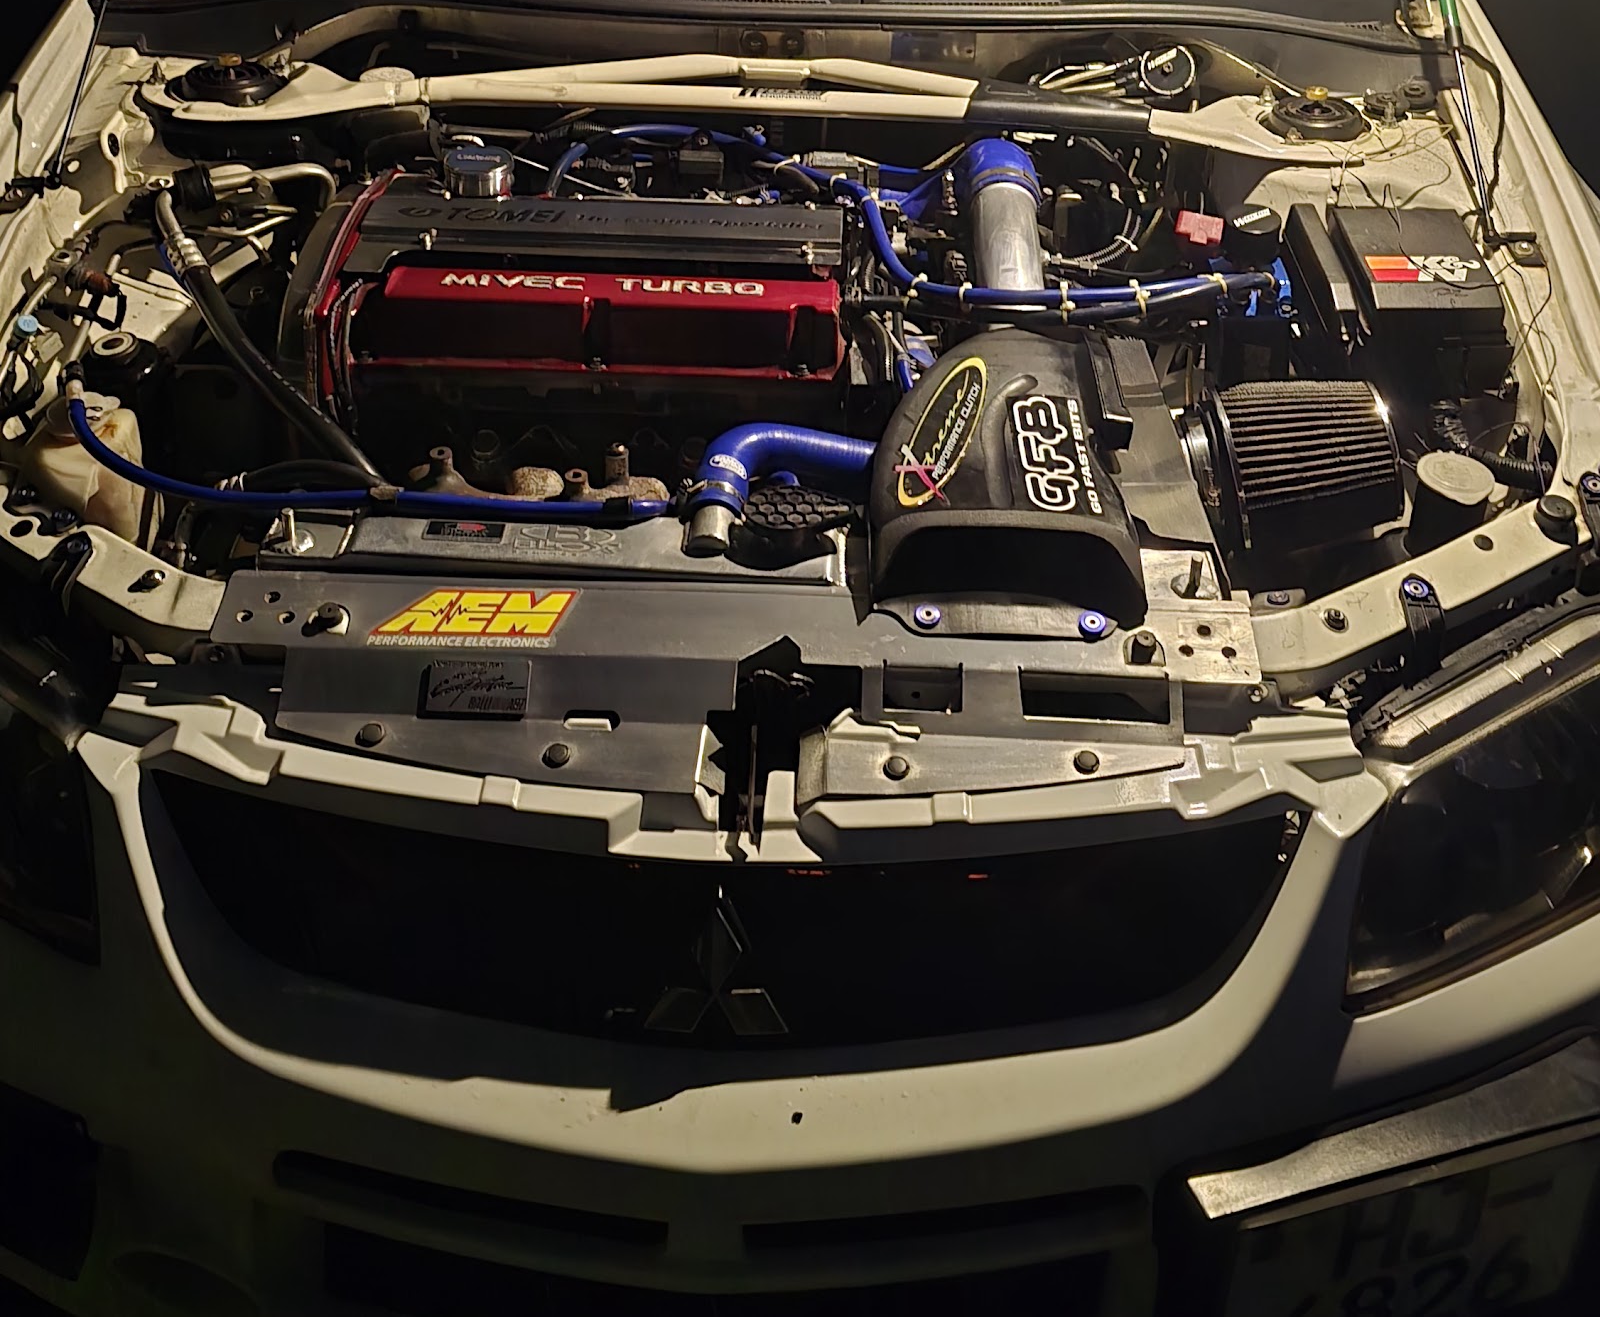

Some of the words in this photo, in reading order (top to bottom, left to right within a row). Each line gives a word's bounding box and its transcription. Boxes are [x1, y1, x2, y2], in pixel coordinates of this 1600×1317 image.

[447, 207, 565, 224] TOMEI
[440, 272, 586, 290] MIVEC
[615, 277, 764, 297] TURBO
[931, 417, 966, 481] PERFORMANCE
[960, 382, 981, 419] CLUTCH
[1066, 399, 1084, 441] BITS
[1012, 396, 1080, 512] GFB
[1074, 441, 1095, 488] FAST
[1086, 489, 1103, 514] GO
[372, 589, 576, 635] AEM
[366, 633, 463, 647] PERFORMANCE
[463, 635, 551, 649] ELECTRONICS
